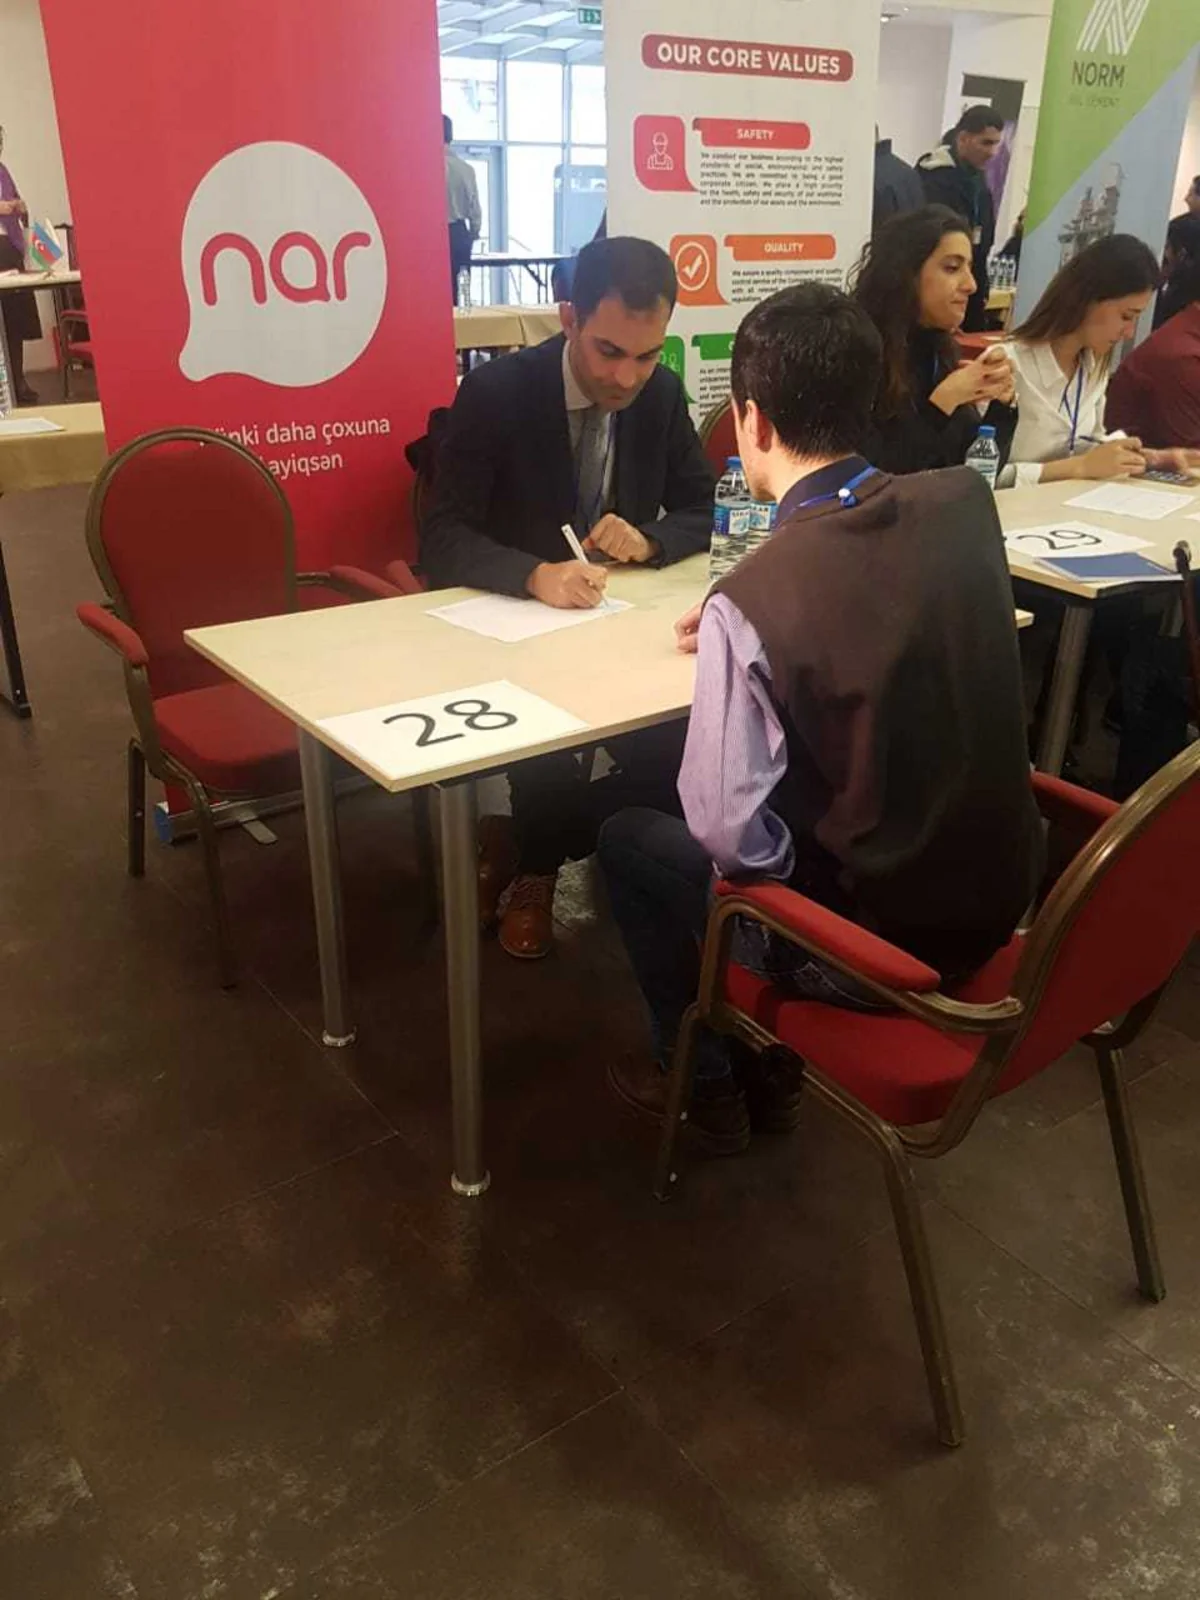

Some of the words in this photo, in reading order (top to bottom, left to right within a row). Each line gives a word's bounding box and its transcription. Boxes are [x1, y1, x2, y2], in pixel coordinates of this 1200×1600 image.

[657, 42, 701, 65] OUR
[706, 46, 762, 70] CORE
[767, 51, 840, 75] VALUES
[1071, 60, 1125, 88] NORM
[736, 128, 774, 140] SAFETY
[764, 242, 804, 254] QUALITY
[200, 231, 372, 306] nar
[206, 424, 259, 446] nki
[266, 421, 316, 444] daha
[322, 418, 390, 445] çoxuna
[260, 452, 343, 480] ayiqsən
[1017, 529, 1102, 550] 29
[383, 699, 518, 747] 28
